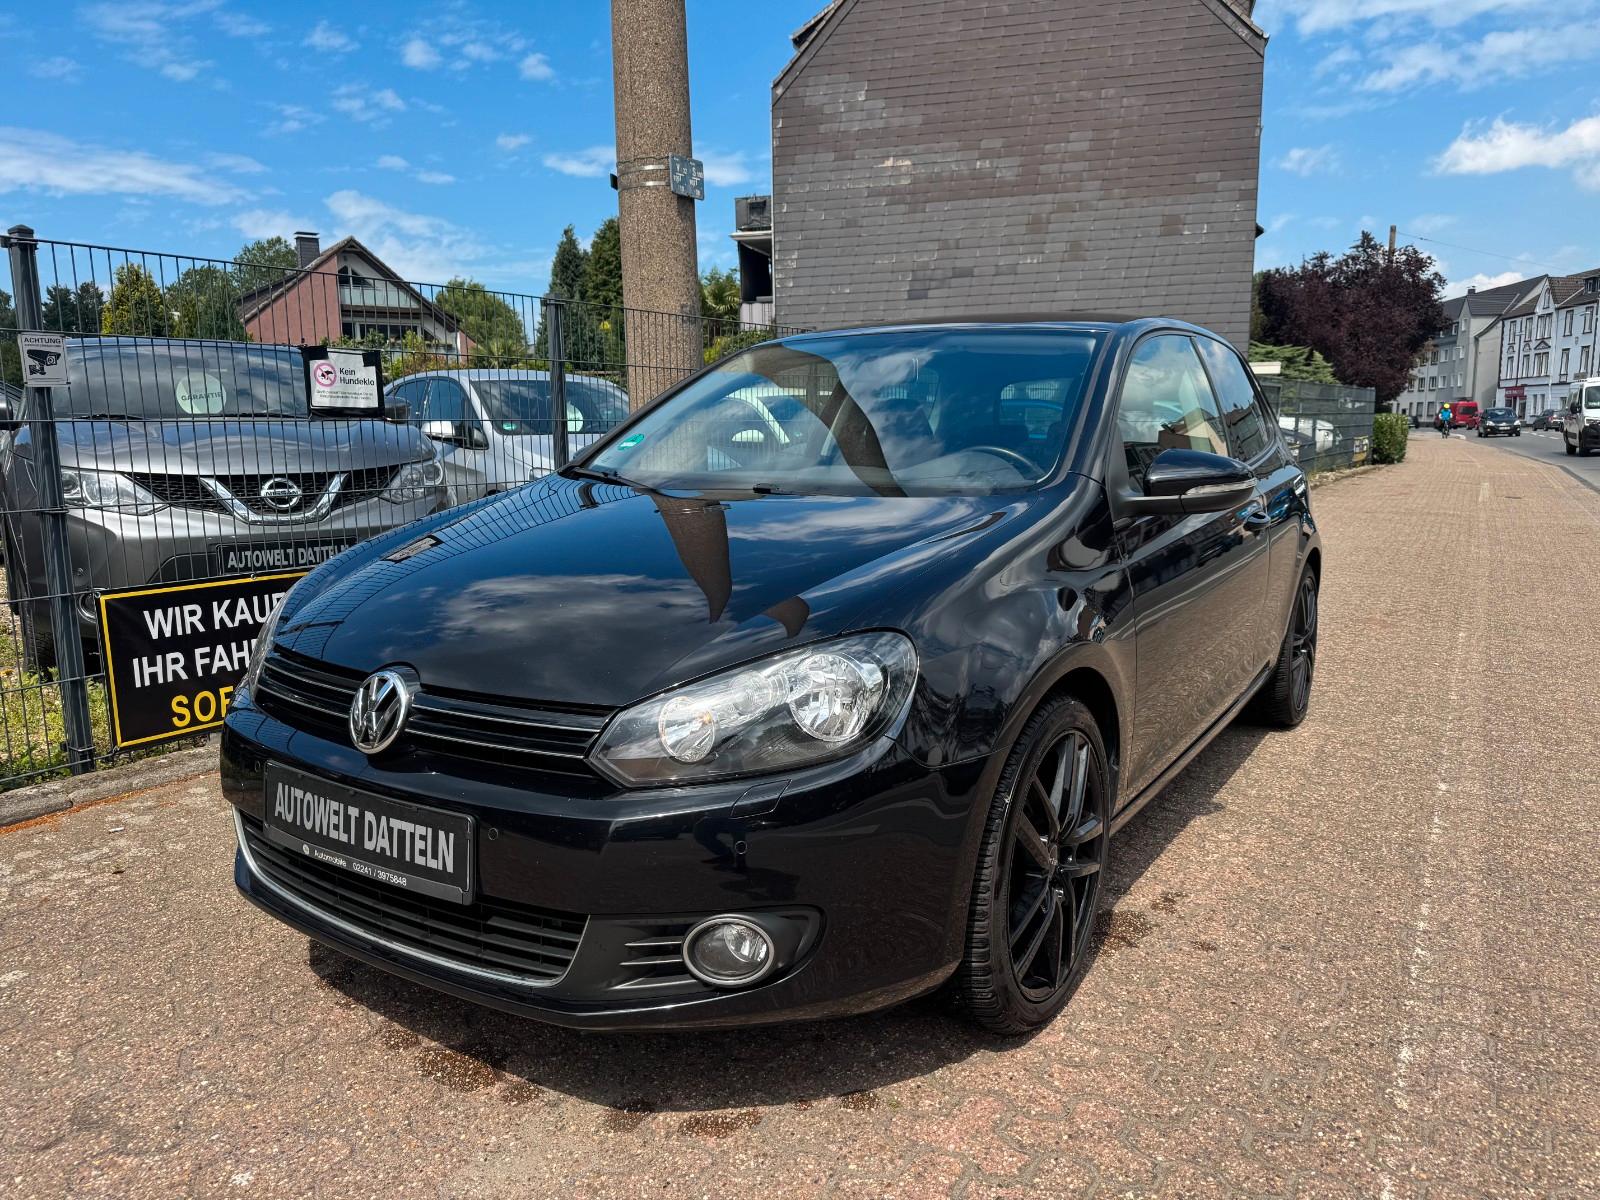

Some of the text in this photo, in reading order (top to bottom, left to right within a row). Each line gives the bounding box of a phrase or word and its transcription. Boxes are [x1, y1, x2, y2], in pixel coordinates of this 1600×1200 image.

[339, 367, 356, 376] Kein
[227, 548, 294, 569] AUTOWELT
[143, 603, 205, 640] WIR
[132, 638, 258, 689] IHR FAH
[274, 781, 455, 874] AUTOWELT DATTELN
[352, 862, 372, 876] 02241
